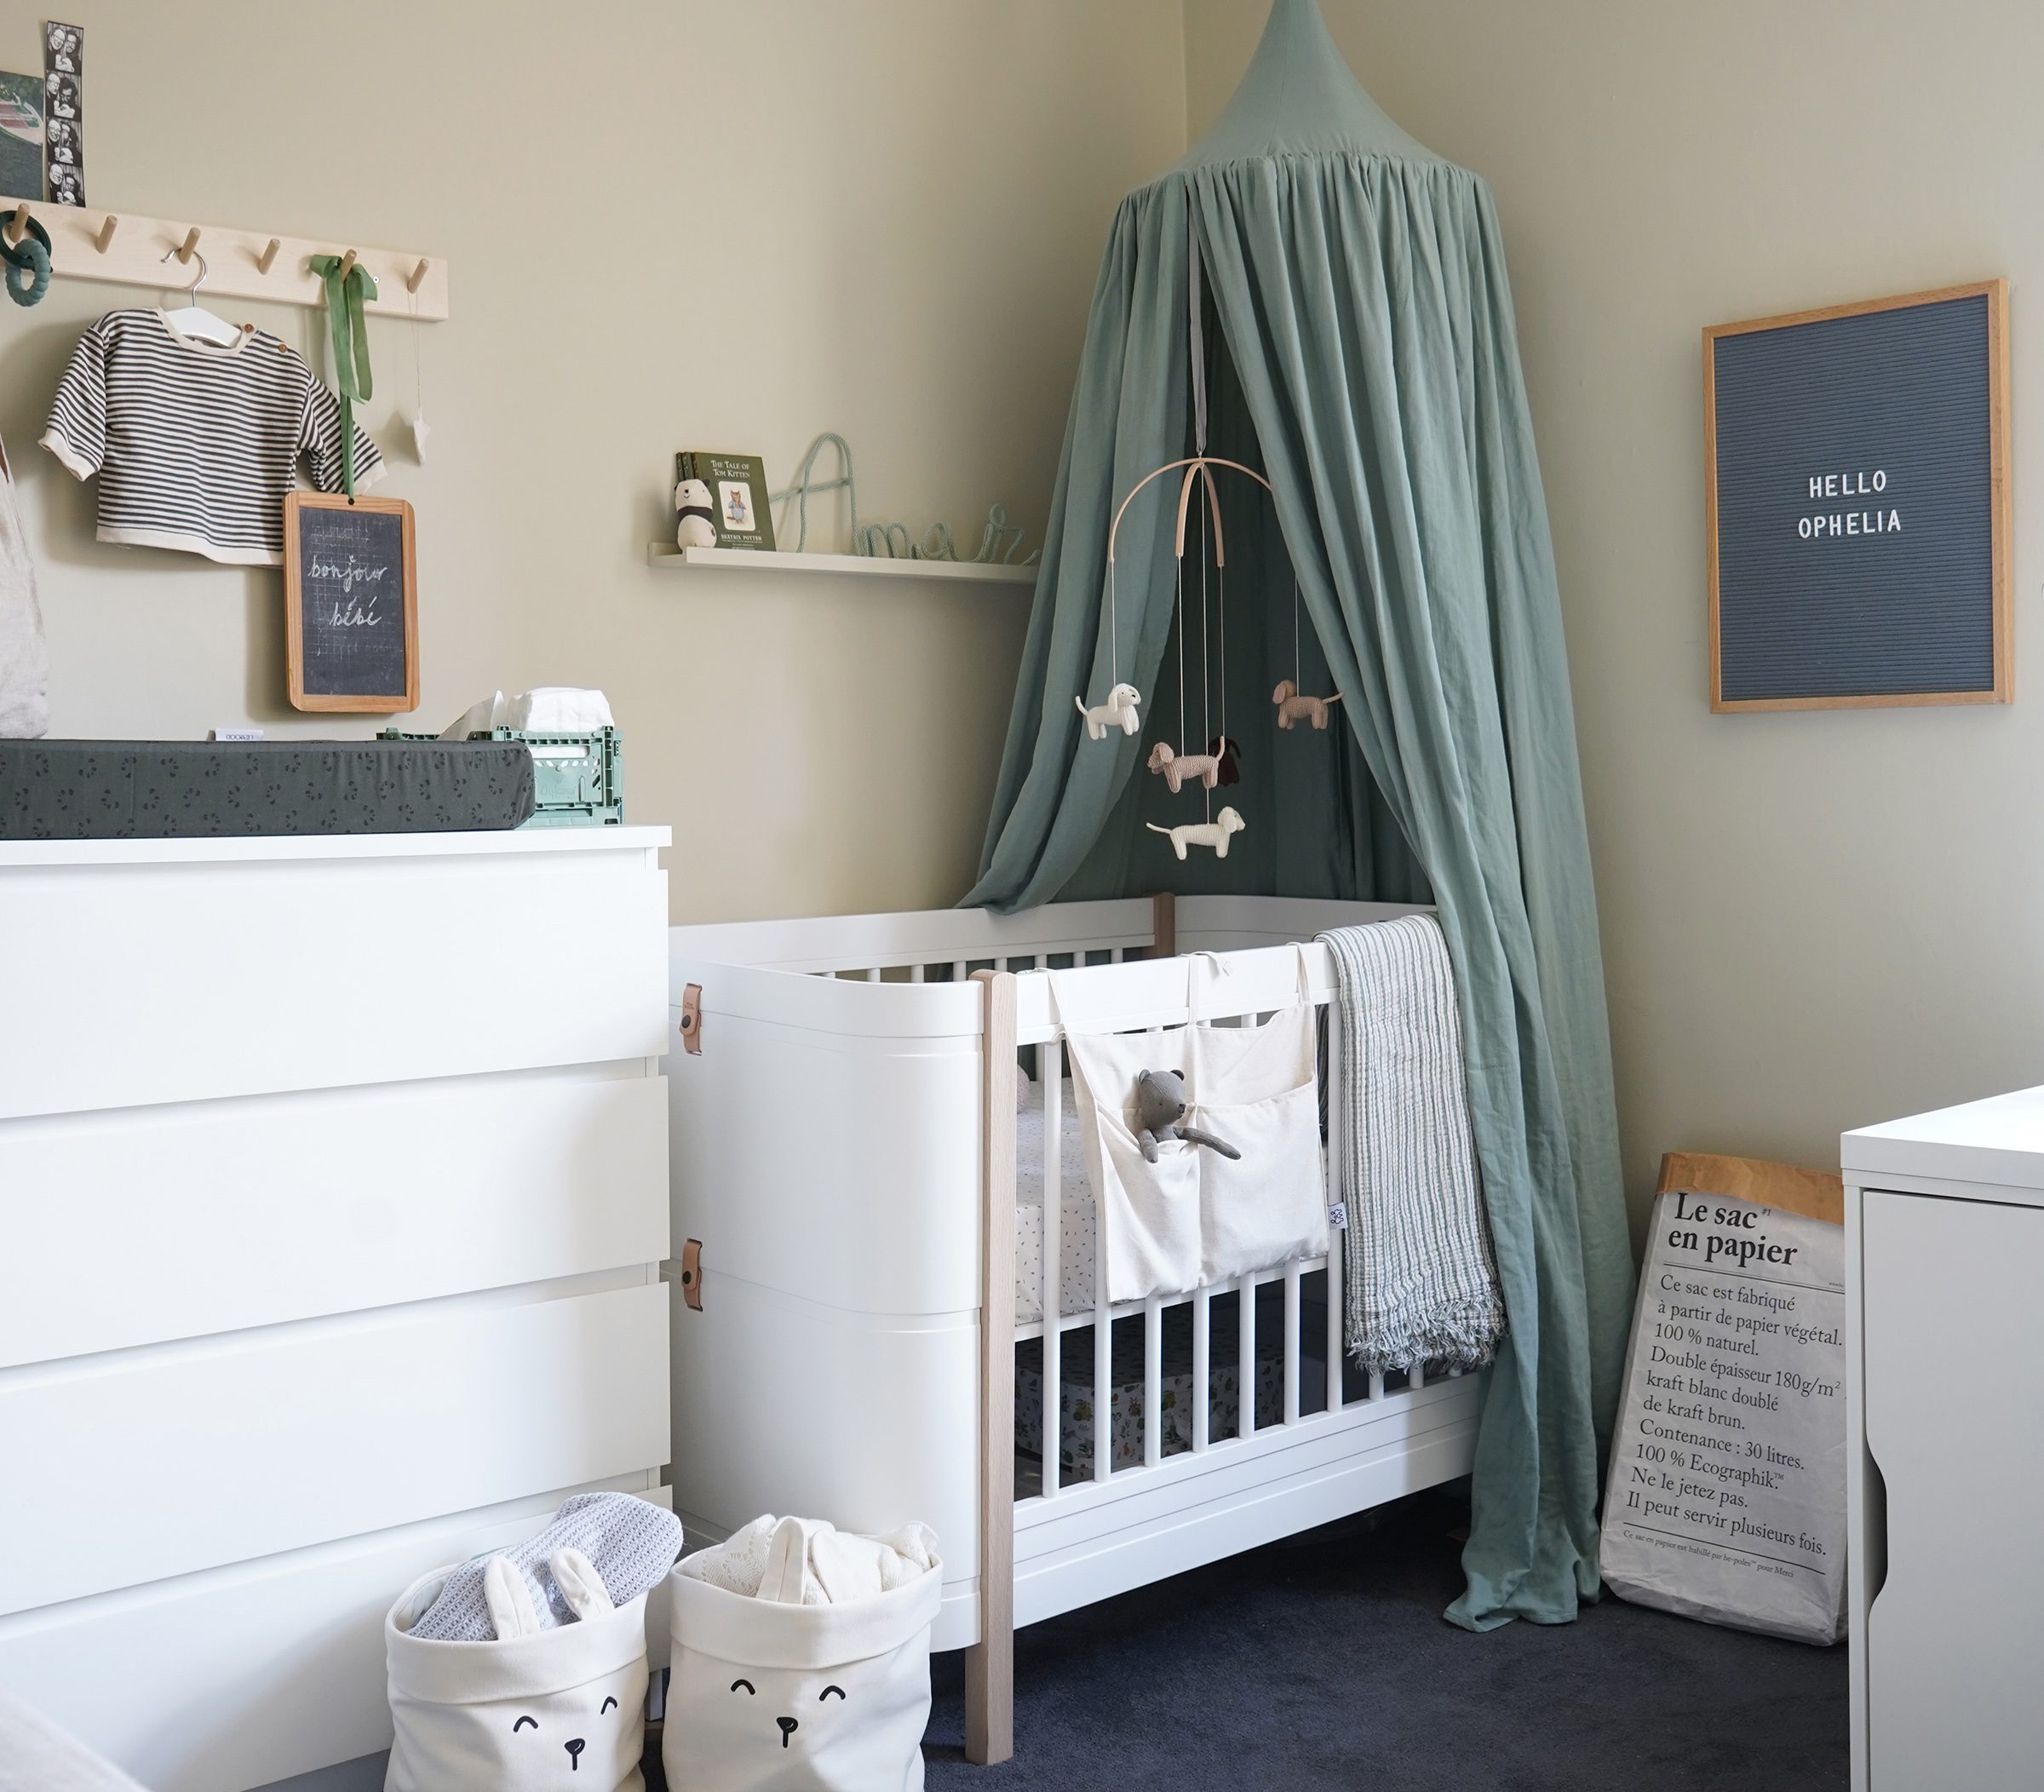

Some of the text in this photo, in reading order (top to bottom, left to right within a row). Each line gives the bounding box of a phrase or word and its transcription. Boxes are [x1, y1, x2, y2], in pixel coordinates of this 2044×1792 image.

[711, 460, 724, 468] THE
[725, 461, 740, 469] TALE
[713, 468, 749, 478] TOM KITTEN
[1810, 470, 1886, 498] HELLO
[1798, 509, 1901, 539] OPHELIA
[307, 554, 388, 593] bonjour
[330, 596, 382, 626] bébé
[1674, 1192, 1708, 1222] Le
[1714, 1205, 1758, 1229] sac
[1668, 1229, 1798, 1268] en papier
[1661, 1274, 1795, 1314] Ce sac est fabriqué
[1655, 1323, 1759, 1356] 100 % naturel.
[1658, 1299, 1843, 1346] à partir de papier végétal.
[1650, 1346, 1707, 1370] Double
[1710, 1359, 1771, 1385] épaisseur
[1646, 1370, 1779, 1411] kraft blanc doublé
[1643, 1394, 1745, 1430] de kraft brun.
[1635, 1444, 1665, 1463] 100
[1670, 1451, 1685, 1467] %
[1639, 1418, 1732, 1453] Contenance
[1744, 1441, 1762, 1459] 30
[1766, 1445, 1805, 1470] litres.
[1630, 1466, 1748, 1508] Ne le jetez pas.
[1626, 1490, 1827, 1555] Il peut servir plusieurs fois.
[1623, 1530, 1633, 1539] Ce
[1655, 1539, 1676, 1548] papier
[1689, 1545, 1711, 1557] habillé
[1757, 1564, 1773, 1572] pour
[1774, 1566, 1794, 1578] Merci
